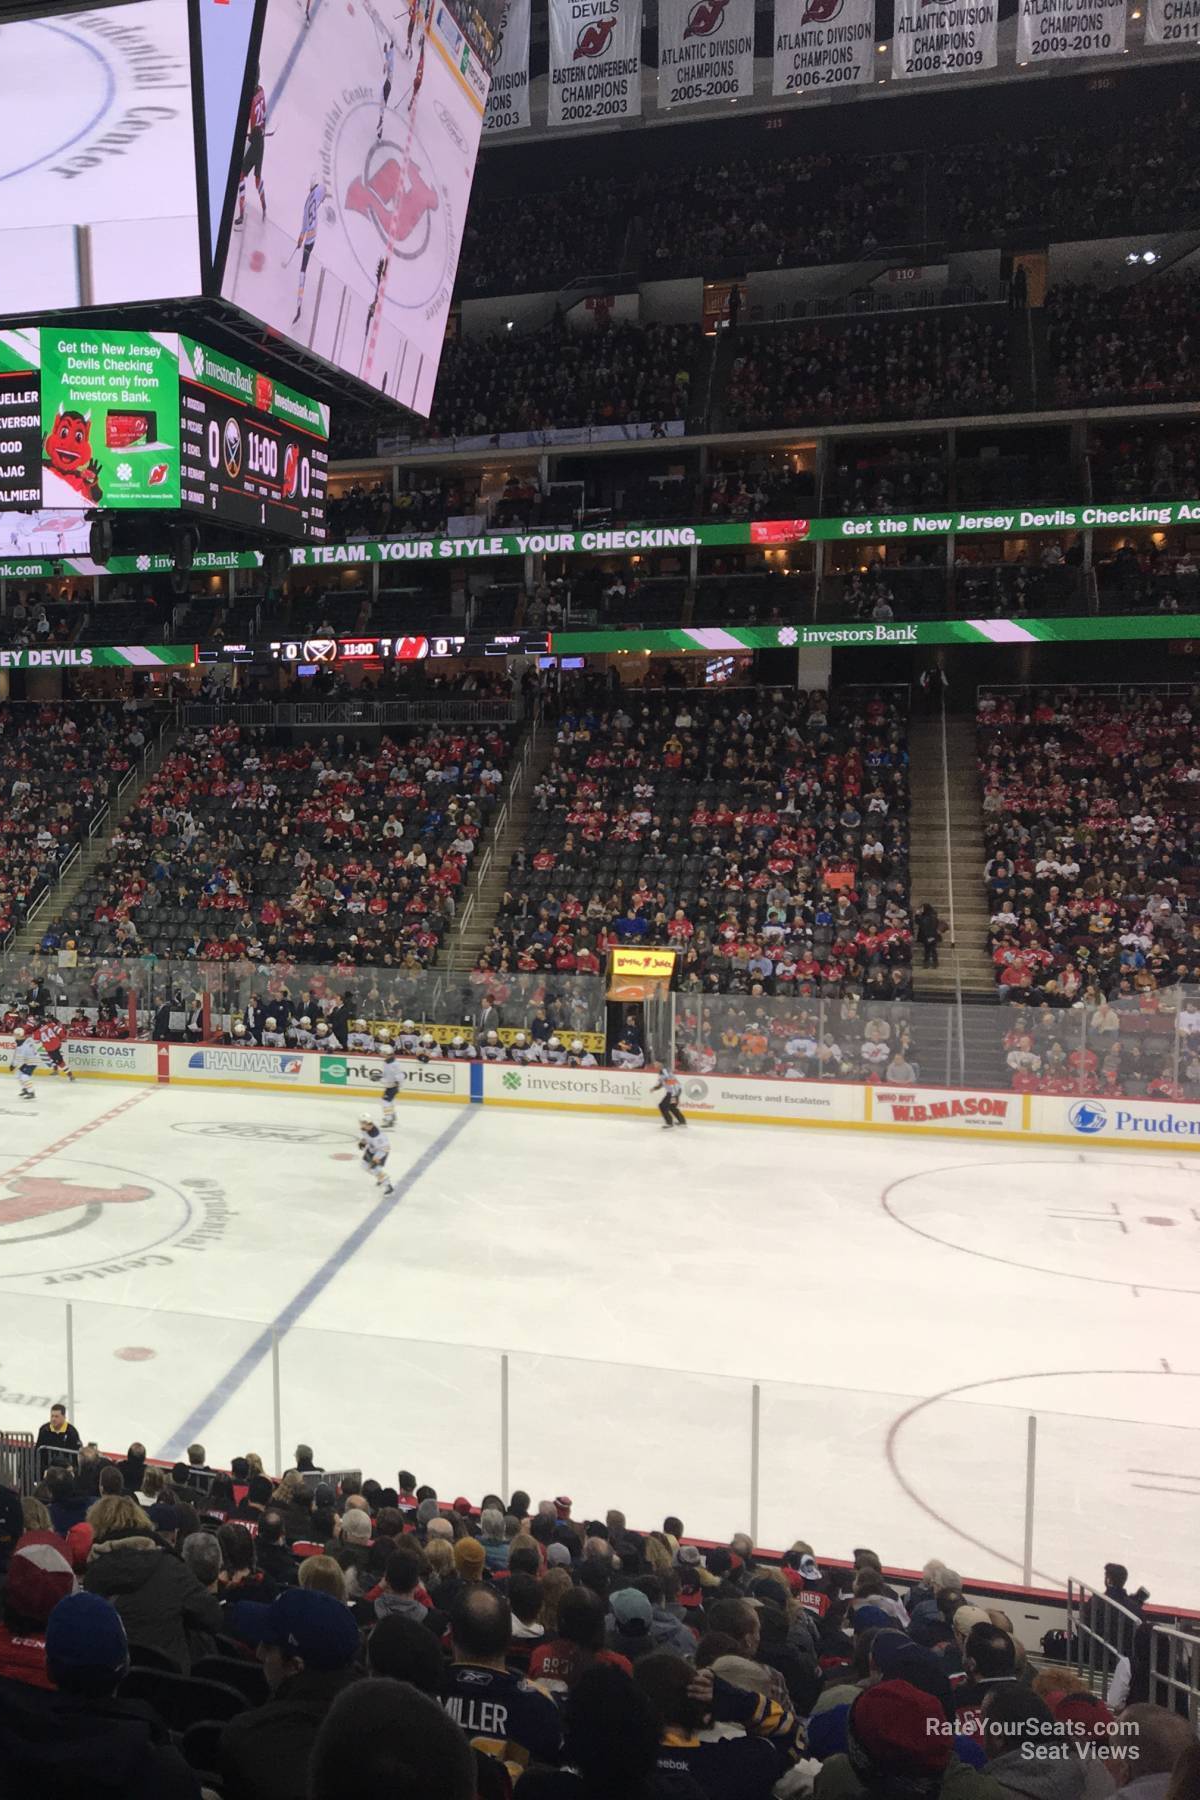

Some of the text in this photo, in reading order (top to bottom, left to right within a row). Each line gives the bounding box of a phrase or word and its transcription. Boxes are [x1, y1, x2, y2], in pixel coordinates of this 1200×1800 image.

[571, 1, 620, 19] DEVILS
[898, 6, 994, 33] ATLANTIC DIVISION
[1040, 14, 1103, 35] CHAMPIONS
[777, 22, 872, 51] ATLANTIC DIVISION
[913, 32, 976, 55] CHAMPIONS
[1032, 33, 1111, 55] 2009-2010
[661, 37, 752, 65] ATLANTIC DIVISION
[793, 46, 853, 70] CHAMPIONS
[905, 51, 983, 73] 2008-2009
[552, 58, 638, 84] EASTERN CONFERENCE
[677, 61, 734, 84] CHAMPIONS
[785, 66, 861, 90] 2006-2007
[561, 80, 628, 103] CHAMPIONS
[671, 79, 739, 102] 2005-2006
[561, 99, 628, 121] 2002-2003
[57, 341, 162, 360] Get the New Jersey
[67, 357, 153, 376] Devils Checking
[60, 373, 159, 390] Account only from
[69, 388, 151, 402] Investors Bank.
[208, 420, 220, 468] 0
[248, 431, 278, 478] 11:00
[301, 456, 310, 498] 0
[841, 519, 873, 536] Get
[878, 518, 908, 534] the
[912, 516, 952, 532] New
[956, 514, 1015, 532] Jersey
[1019, 510, 1076, 528] Devils
[1081, 506, 1173, 526] Checking
[311, 528, 702, 563] TEAM. YOUR STYLE. YOUR CHECKING.
[28, 648, 93, 666] DEVILS
[343, 642, 374, 656] 11:00
[67, 1044, 135, 1057] EAST COAST
[67, 1056, 104, 1067] POWER
[115, 1058, 136, 1069] GAS
[204, 1051, 282, 1073] HALMAR
[720, 1090, 831, 1107] Elevators and Escalators
